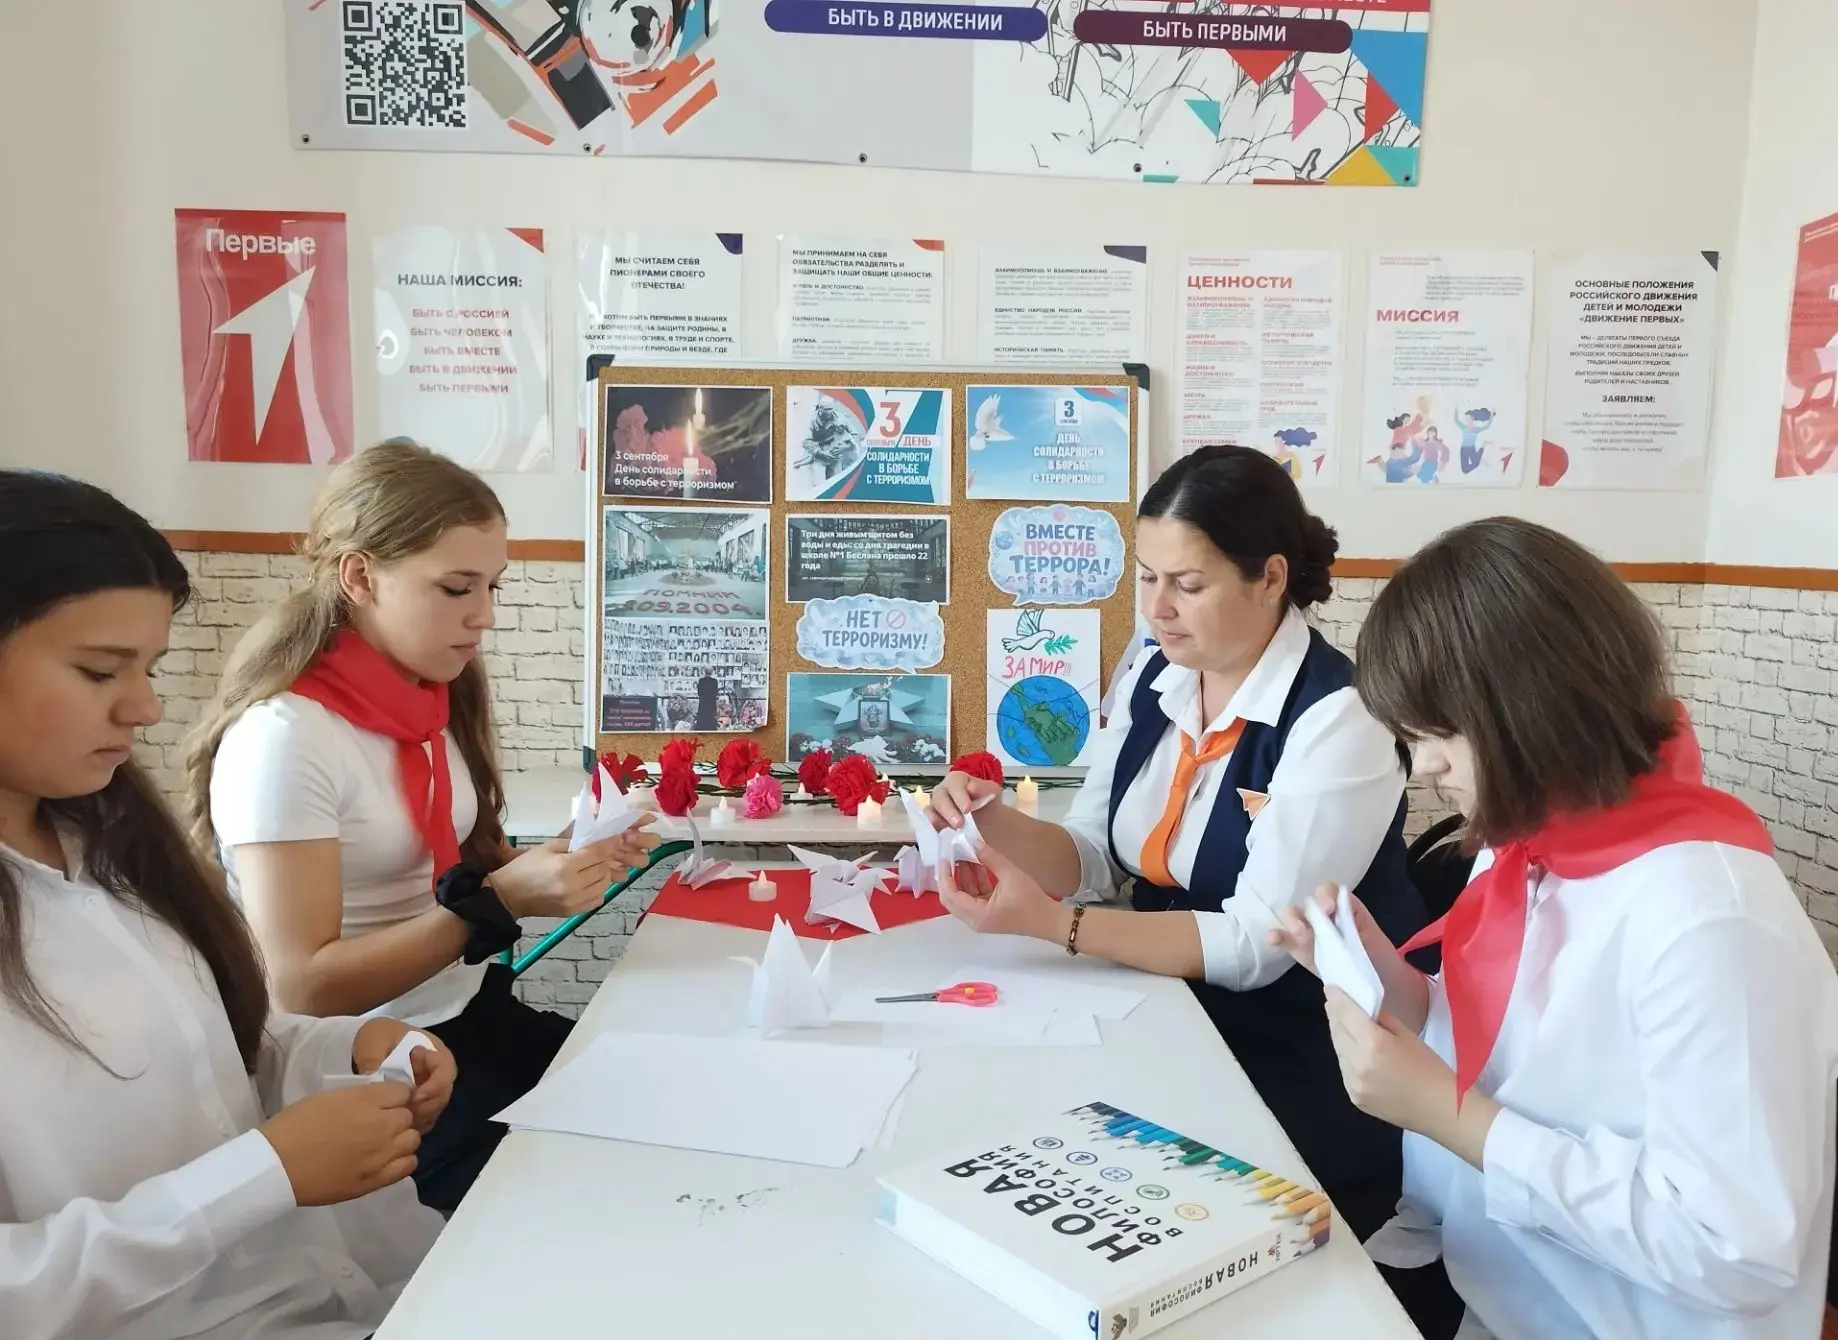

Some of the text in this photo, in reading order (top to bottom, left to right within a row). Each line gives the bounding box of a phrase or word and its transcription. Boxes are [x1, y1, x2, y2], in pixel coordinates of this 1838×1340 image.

[828, 8, 1004, 32] БЫТЬ В ДВИЖЕНИИ
[1142, 20, 1288, 43] БЫТЬ ПЕРВЫМИ
[205, 228, 317, 261] Первые
[807, 250, 856, 258] ПРИНИМАЕМ
[633, 257, 675, 265] СЧИТАЕМ
[792, 258, 854, 267] ОБЯЗАТЕЛЬСТВА
[609, 269, 706, 278] ПИОНЕРАМИ СВОЕГО
[792, 268, 836, 276] ЗАЩИЩАТЬ
[862, 270, 889, 278] ОБЩИЕ
[397, 273, 523, 288] НАША МИССИЯ:
[631, 282, 685, 290] ОТЕЧЕСТВА!
[1187, 275, 1293, 290] ЦЕННОСТИ
[1575, 280, 1694, 289] ОСНОВНЫЕ ПОЛОЖЕНИЯ
[1569, 291, 1698, 301] РОССИЙСКОГО ДВИЖЕНИЯ
[412, 308, 443, 318] БЫТЬ
[1583, 303, 1614, 312] ДЕТЕЙ
[1625, 304, 1682, 312] МОЛОДЕЖИ
[1376, 309, 1460, 323] МИССИЯ
[1579, 315, 1685, 323] «ДВИЖЕНИЕ ПЕРВЫХ»
[410, 327, 441, 337] БЫТЬ
[424, 347, 502, 356] БЫТЬ ВМЕСТЕ
[409, 365, 440, 374] БЫТЬ
[452, 365, 517, 376] ДВИЖЕНИИ
[419, 384, 509, 393] БЫТЬ ПЕРВЫМИ
[1602, 395, 1656, 403] ЗАЯВЛЯЕМ:
[1063, 400, 1075, 418] 3
[879, 401, 902, 438] 3
[903, 435, 931, 447] ДЕНЬ
[1057, 432, 1080, 445] ДЕНЬ
[615, 450, 669, 463] 3 сентября
[866, 451, 930, 463] СОЛИДАРНОСТИ
[1033, 446, 1104, 458] СОЛИДАРНОСТИ
[614, 463, 712, 477] День солидарсти
[878, 463, 919, 474] В БОРЬБЕ
[1048, 460, 1054, 470] В
[622, 476, 659, 488] борьбе
[667, 479, 735, 491] терроризмом
[866, 474, 930, 485] С ТЕРРОРИЗМОМ
[1033, 473, 1105, 484] С ТЕРРОРИЗМОМ
[801, 530, 818, 539] Три
[818, 531, 835, 539] дня
[899, 530, 914, 539] без
[1026, 523, 1096, 541] ВМЕСТЕ
[1024, 541, 1097, 557] ПРОТИВ
[883, 553, 917, 561] прошло
[917, 552, 928, 560] 22
[1009, 554, 1111, 576] ТЕРРОРА!
[643, 589, 741, 600] ПОМНИМ
[846, 610, 883, 629] НЕТ
[822, 630, 928, 650] ТЕРРОРИЗМУ!
[1002, 655, 1026, 679] ЗА
[1000, 1144, 1184, 1238] ВОСПИТАНИЯ
[977, 1151, 1163, 1246] ФИЛОСОФИЯ
[943, 1158, 1145, 1264] НОВАЯ
[1205, 1251, 1259, 1290] НОВАЯ
[1150, 1278, 1203, 1309] ВОСПИТАНИЯ
[1150, 1286, 1203, 1317] ФИЛОСОФИЯ
